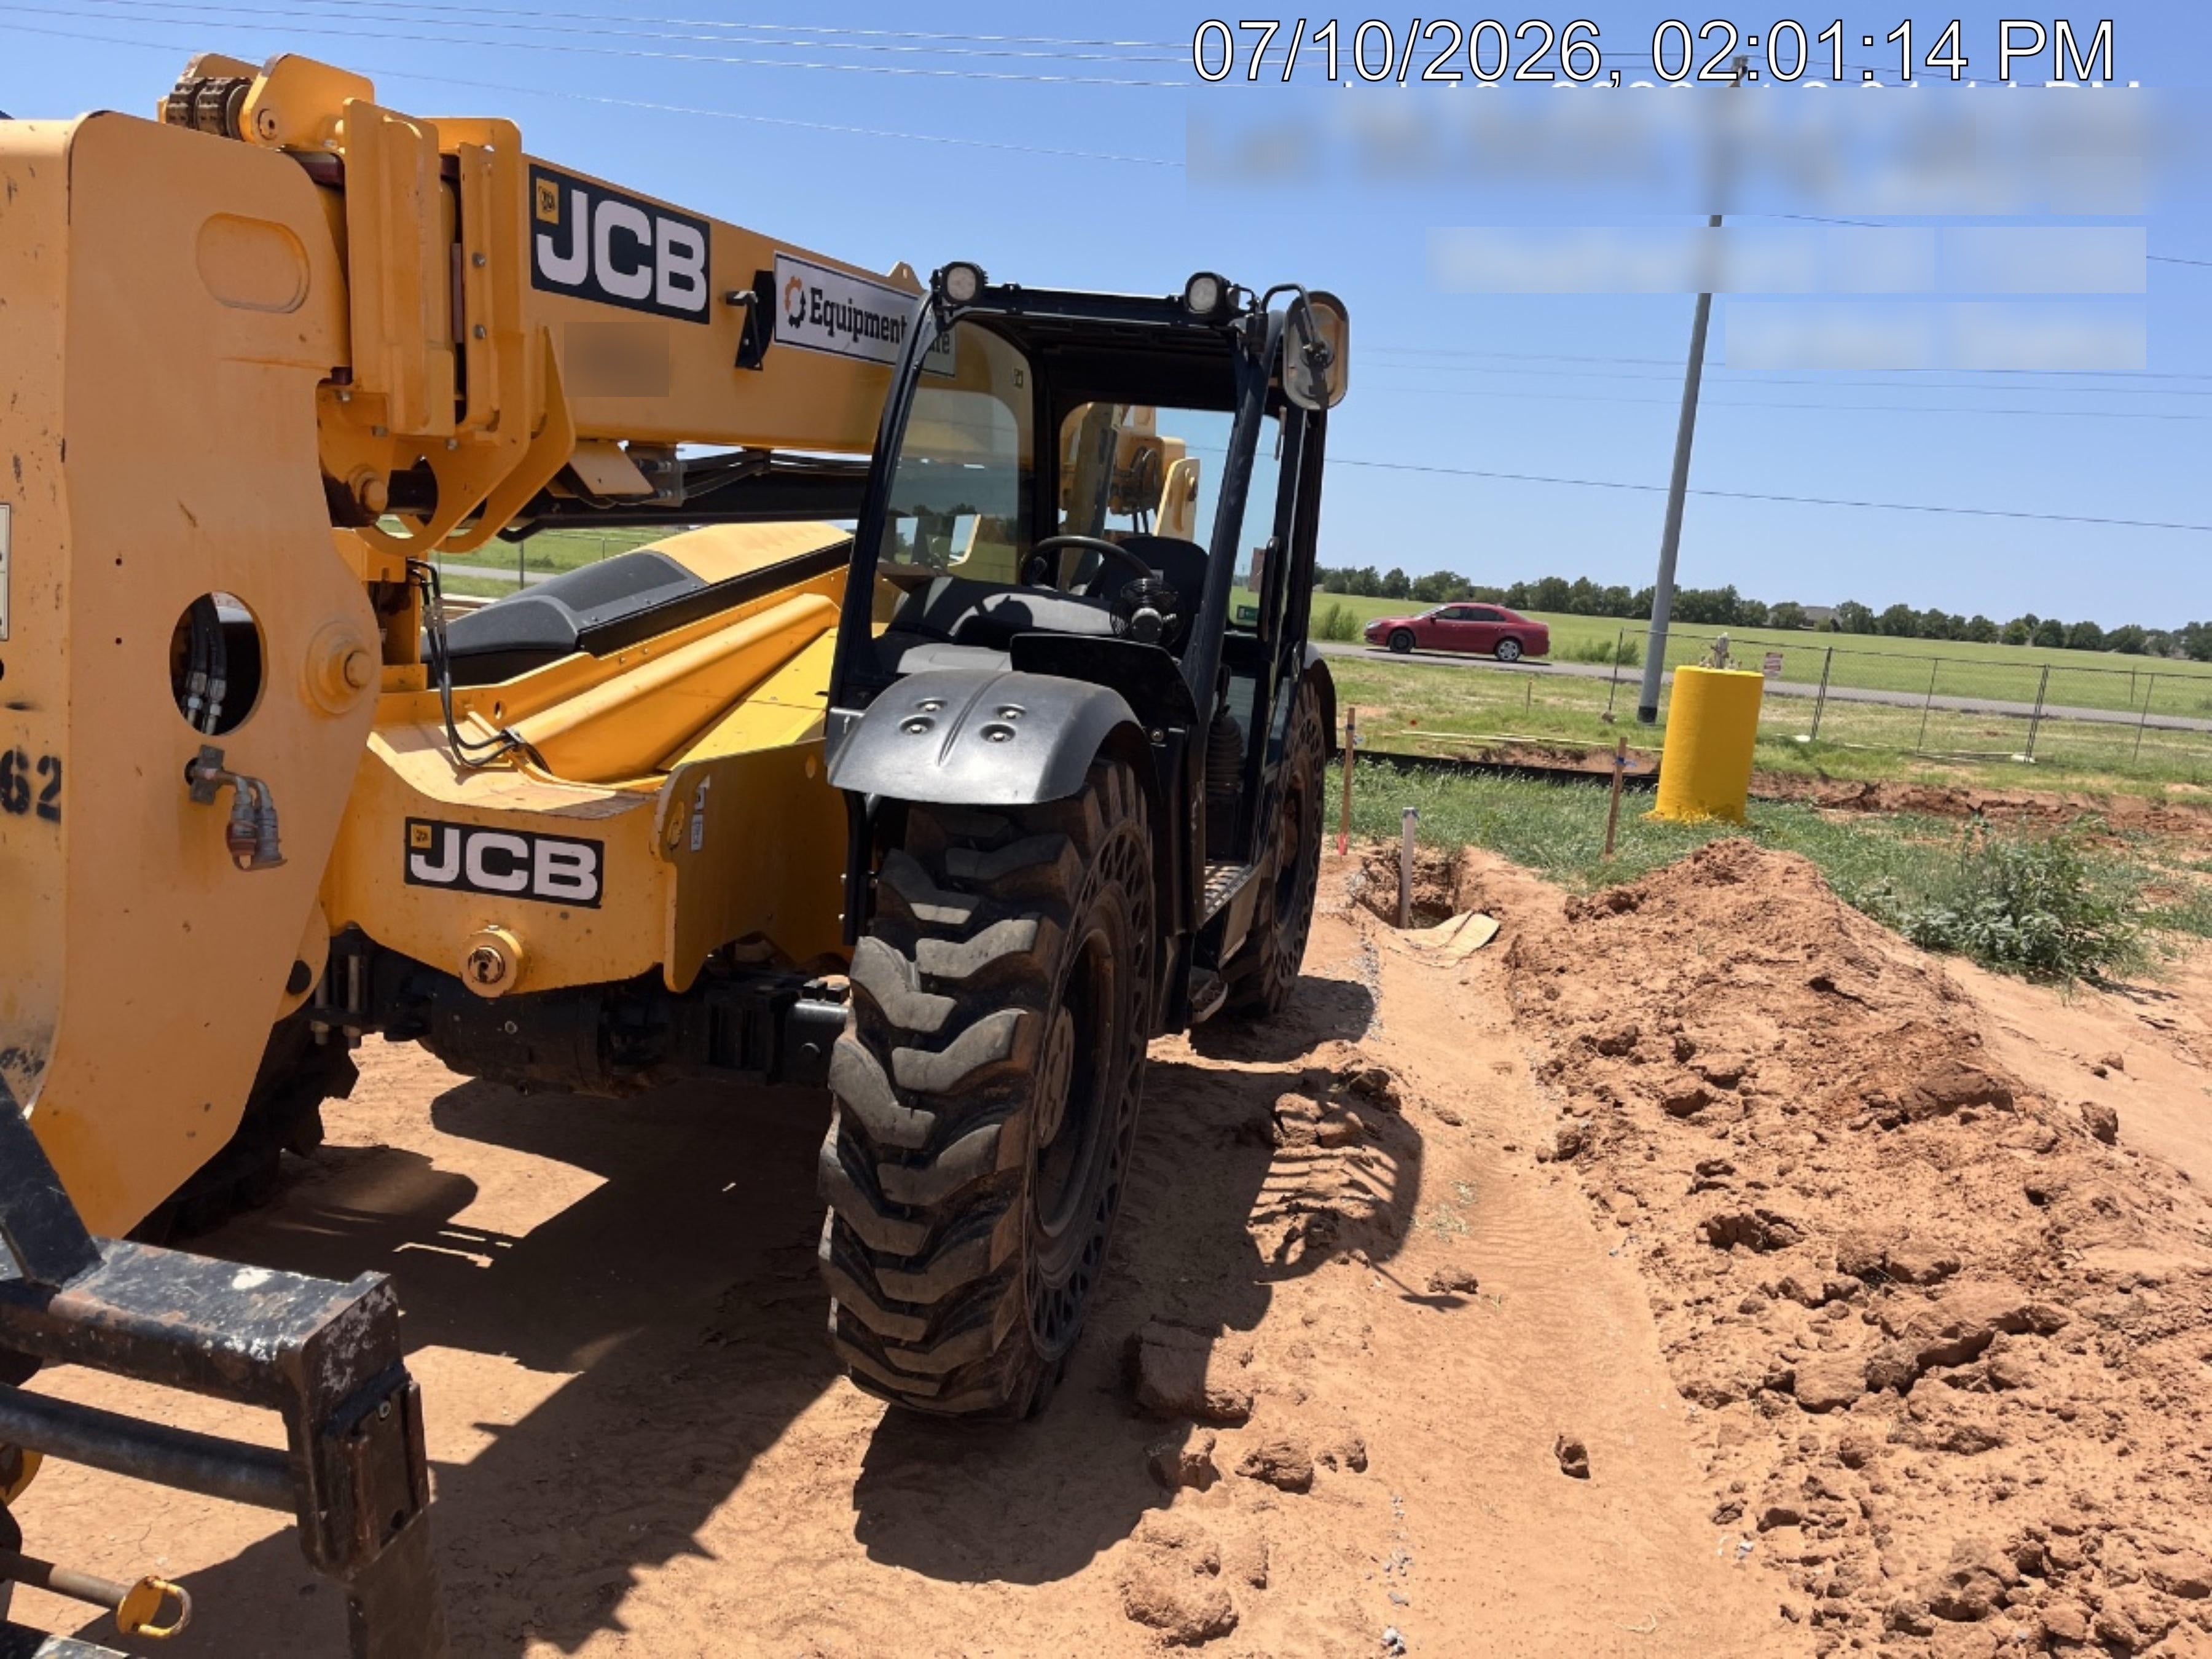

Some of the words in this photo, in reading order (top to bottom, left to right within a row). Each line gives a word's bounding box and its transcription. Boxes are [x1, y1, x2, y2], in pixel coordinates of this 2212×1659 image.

[536, 189, 707, 312] JCB
[0, 749, 61, 825] 62
[410, 828, 598, 900] JCB
